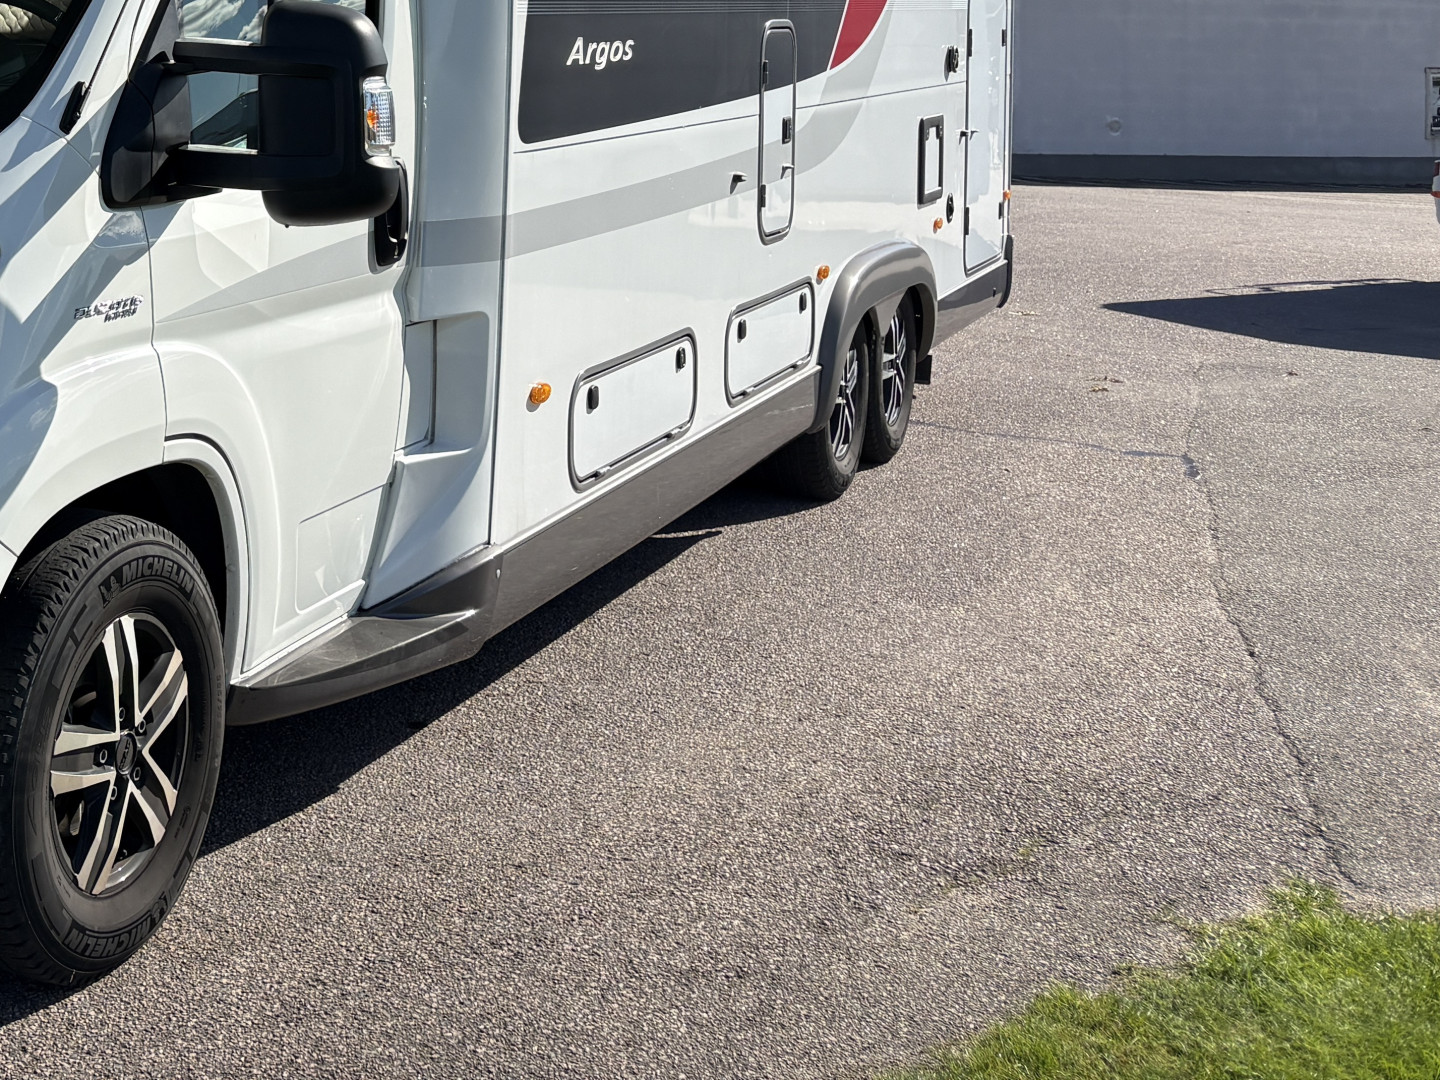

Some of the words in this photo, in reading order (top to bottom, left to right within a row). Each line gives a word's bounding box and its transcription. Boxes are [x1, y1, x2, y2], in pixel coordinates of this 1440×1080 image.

[566, 36, 635, 70] Argos
[121, 556, 194, 594] MICHELIN
[63, 916, 151, 957] MICHELIN
